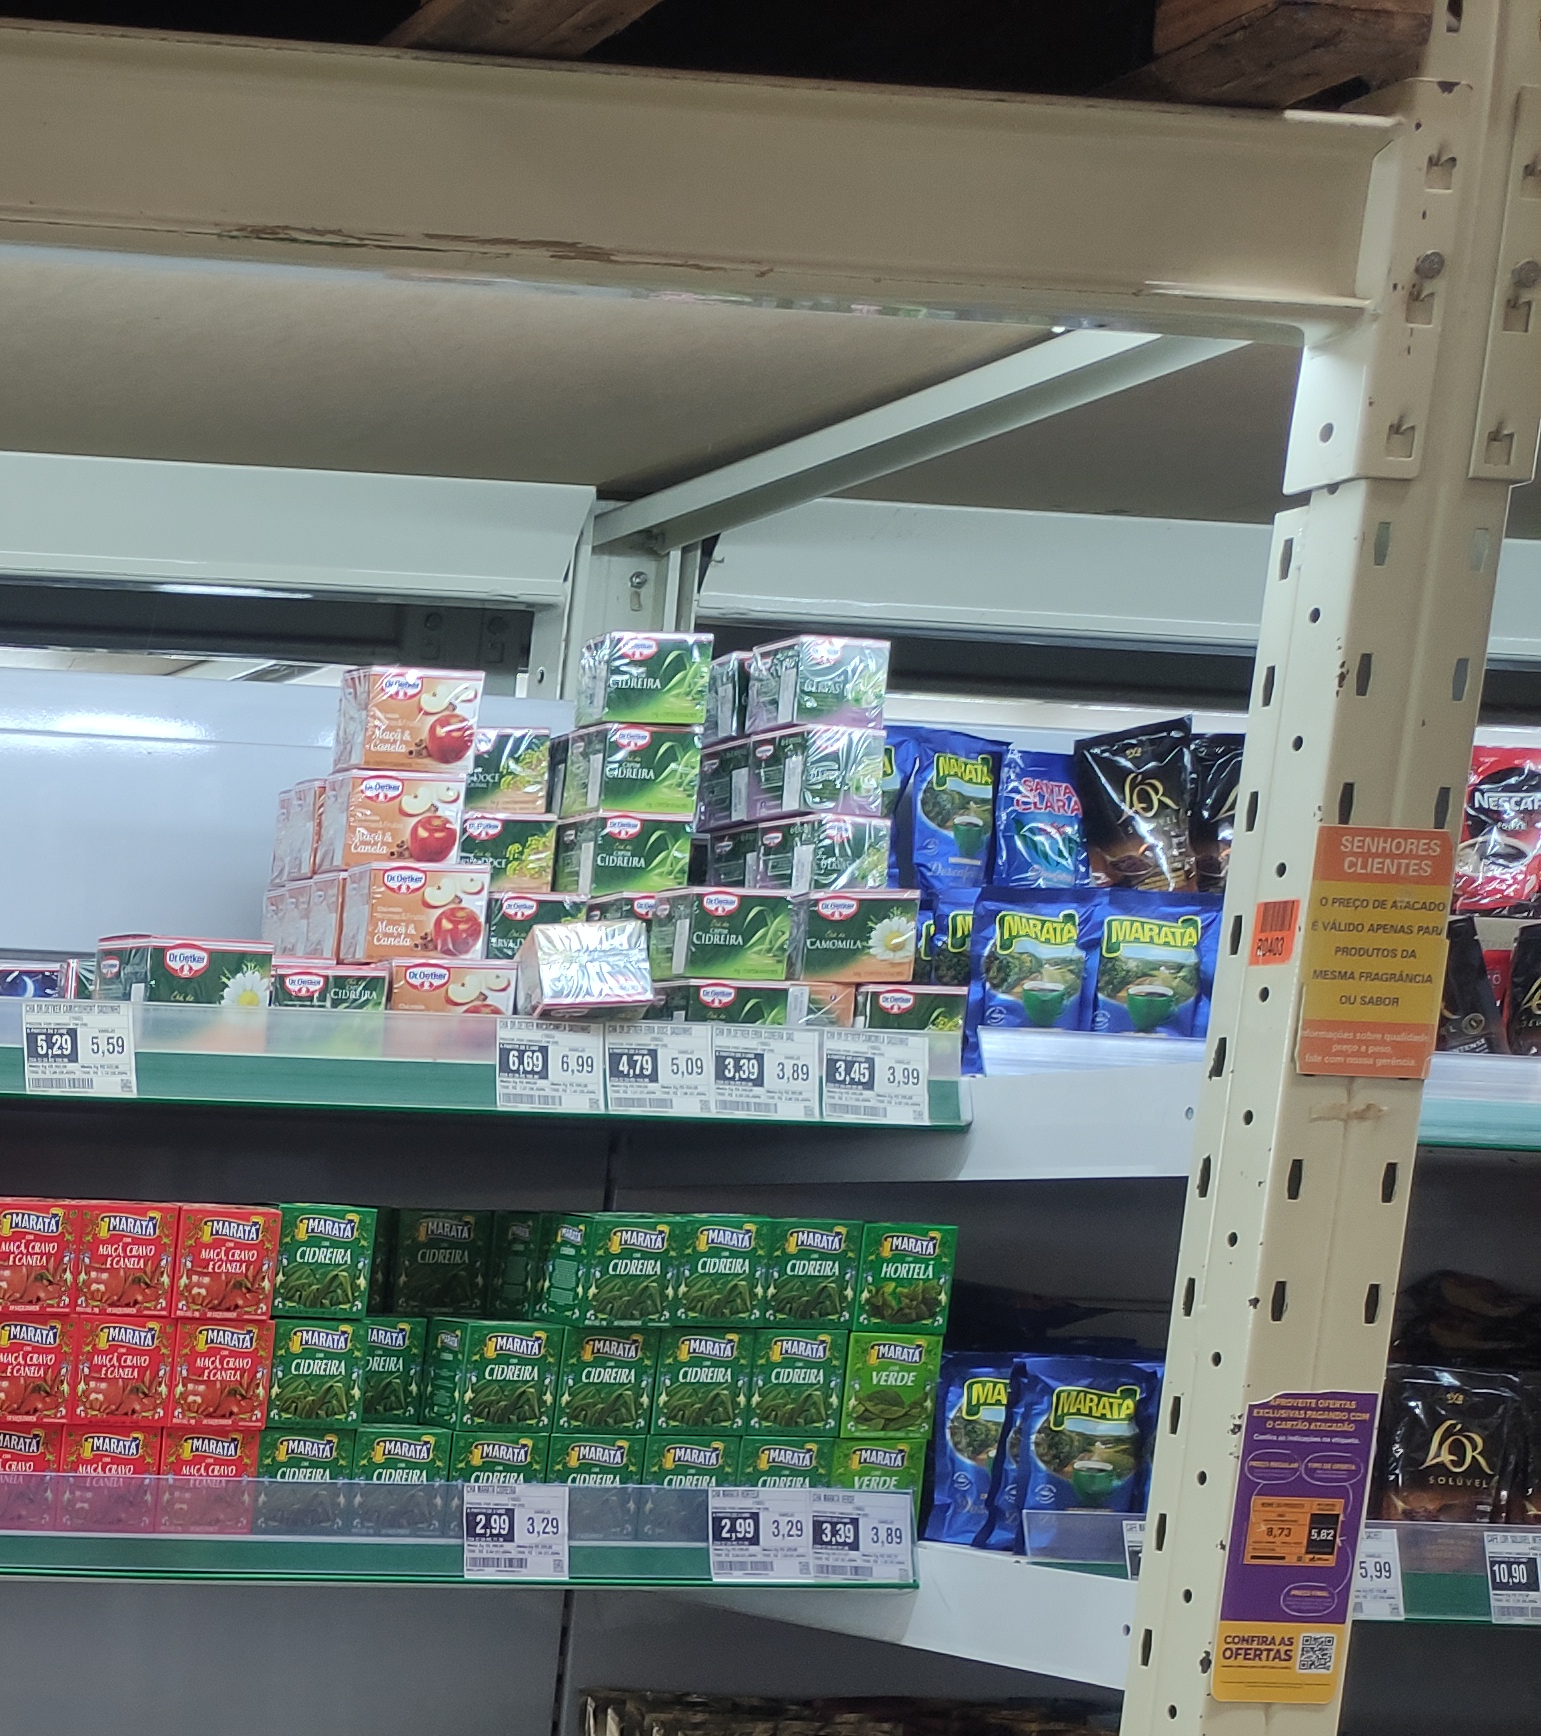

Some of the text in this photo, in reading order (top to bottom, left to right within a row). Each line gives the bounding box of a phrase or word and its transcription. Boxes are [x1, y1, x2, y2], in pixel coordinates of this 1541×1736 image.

[1021, 776, 1075, 799] SANTA
[1016, 793, 1081, 815] CLARA
[1341, 836, 1441, 855] SENHORES
[1344, 857, 1432, 876] CLIENTES
[1320, 897, 1445, 911] O PREÇO DE ATACADO
[1323, 920, 1364, 932] VÁLIDO
[1368, 924, 1413, 935] APENAS
[374, 934, 411, 946] Canela
[806, 939, 861, 950] CAMOMILA
[1335, 947, 1417, 959] PRODUTOS DA
[1312, 969, 1432, 983] MESMA FRAGRÂNCIA
[1339, 995, 1399, 1006] OU SABOR
[834, 1061, 920, 1088] 3,45 3,99
[608, 1259, 661, 1276] CIDREIRA
[881, 1261, 933, 1278] HORTELÃ
[871, 1371, 915, 1386] VERDE
[821, 1523, 903, 1545] 3,39 3,89
[1493, 1563, 1527, 1585] 10,90
[1224, 1635, 1293, 1646] CONFIRA AS
[1223, 1648, 1293, 1661] OFERTAS
